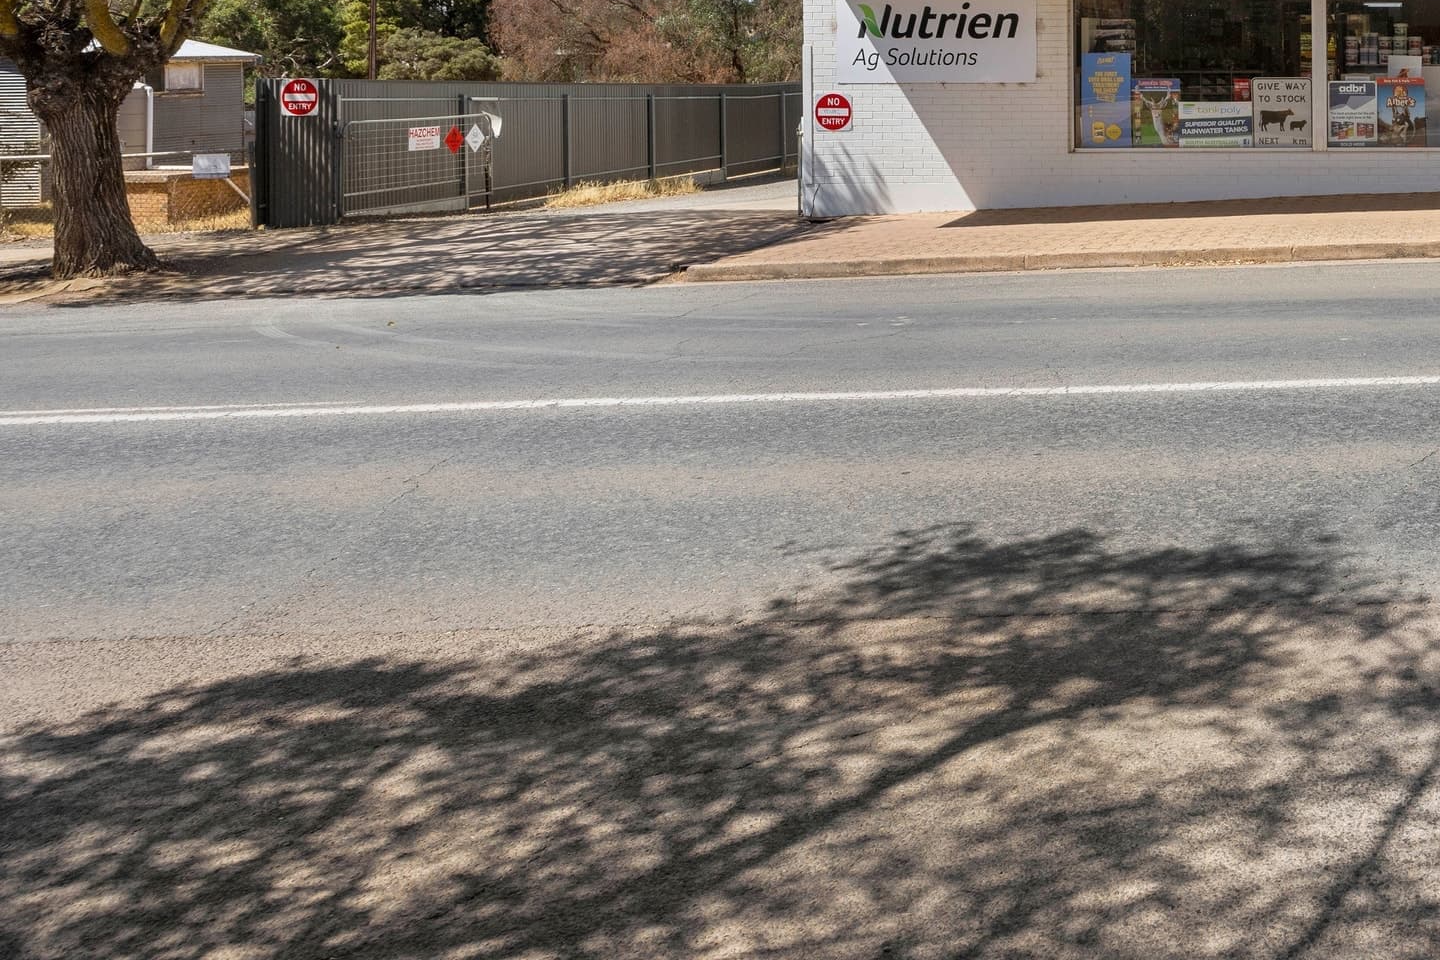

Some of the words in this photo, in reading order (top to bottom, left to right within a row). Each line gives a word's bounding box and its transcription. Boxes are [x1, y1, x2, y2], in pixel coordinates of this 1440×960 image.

[857, 2, 1019, 39] Nutrien
[852, 47, 880, 71] Ag
[885, 47, 978, 66] Solutions
[294, 83, 307, 92] NO
[1257, 82, 1280, 90] GIVE
[1285, 82, 1307, 90] WAY
[1338, 83, 1367, 93] adbri
[827, 97, 840, 106] NO
[1259, 95, 1271, 103] TO
[1276, 95, 1306, 103] STOCK
[288, 103, 312, 111] ENTRY
[1196, 105, 1241, 115] tankpoly
[408, 127, 441, 139] HAZCHEM
[1181, 127, 1224, 135] RAINWATER
[1225, 126, 1249, 134] TANKS
[1258, 137, 1280, 145] NEXT
[1292, 137, 1307, 145] km
